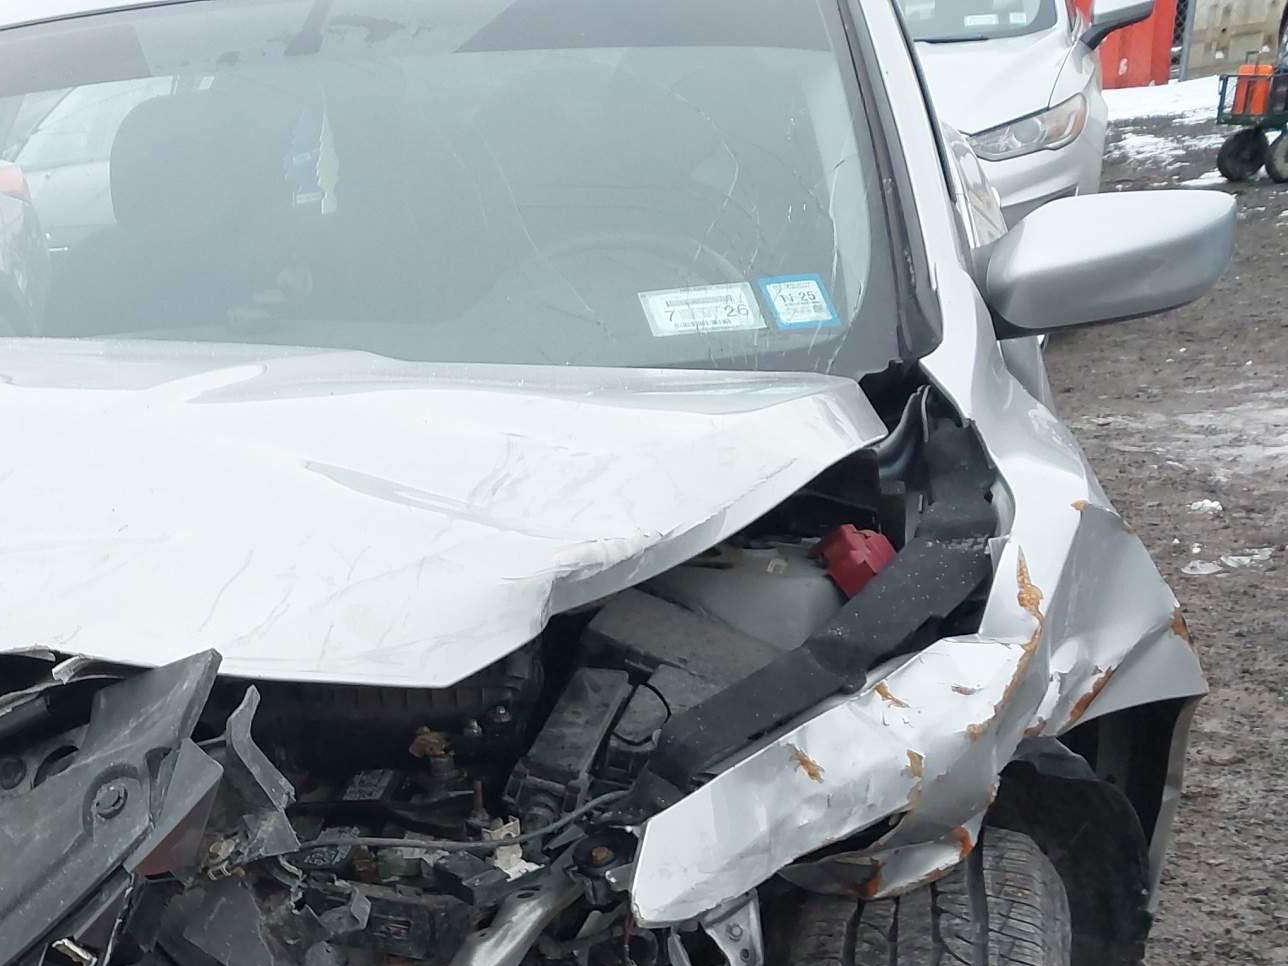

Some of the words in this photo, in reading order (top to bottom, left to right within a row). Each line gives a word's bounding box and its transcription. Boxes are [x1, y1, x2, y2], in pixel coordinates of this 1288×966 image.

[798, 291, 816, 302] 25
[664, 310, 675, 322] 7
[724, 303, 749, 318] 26
